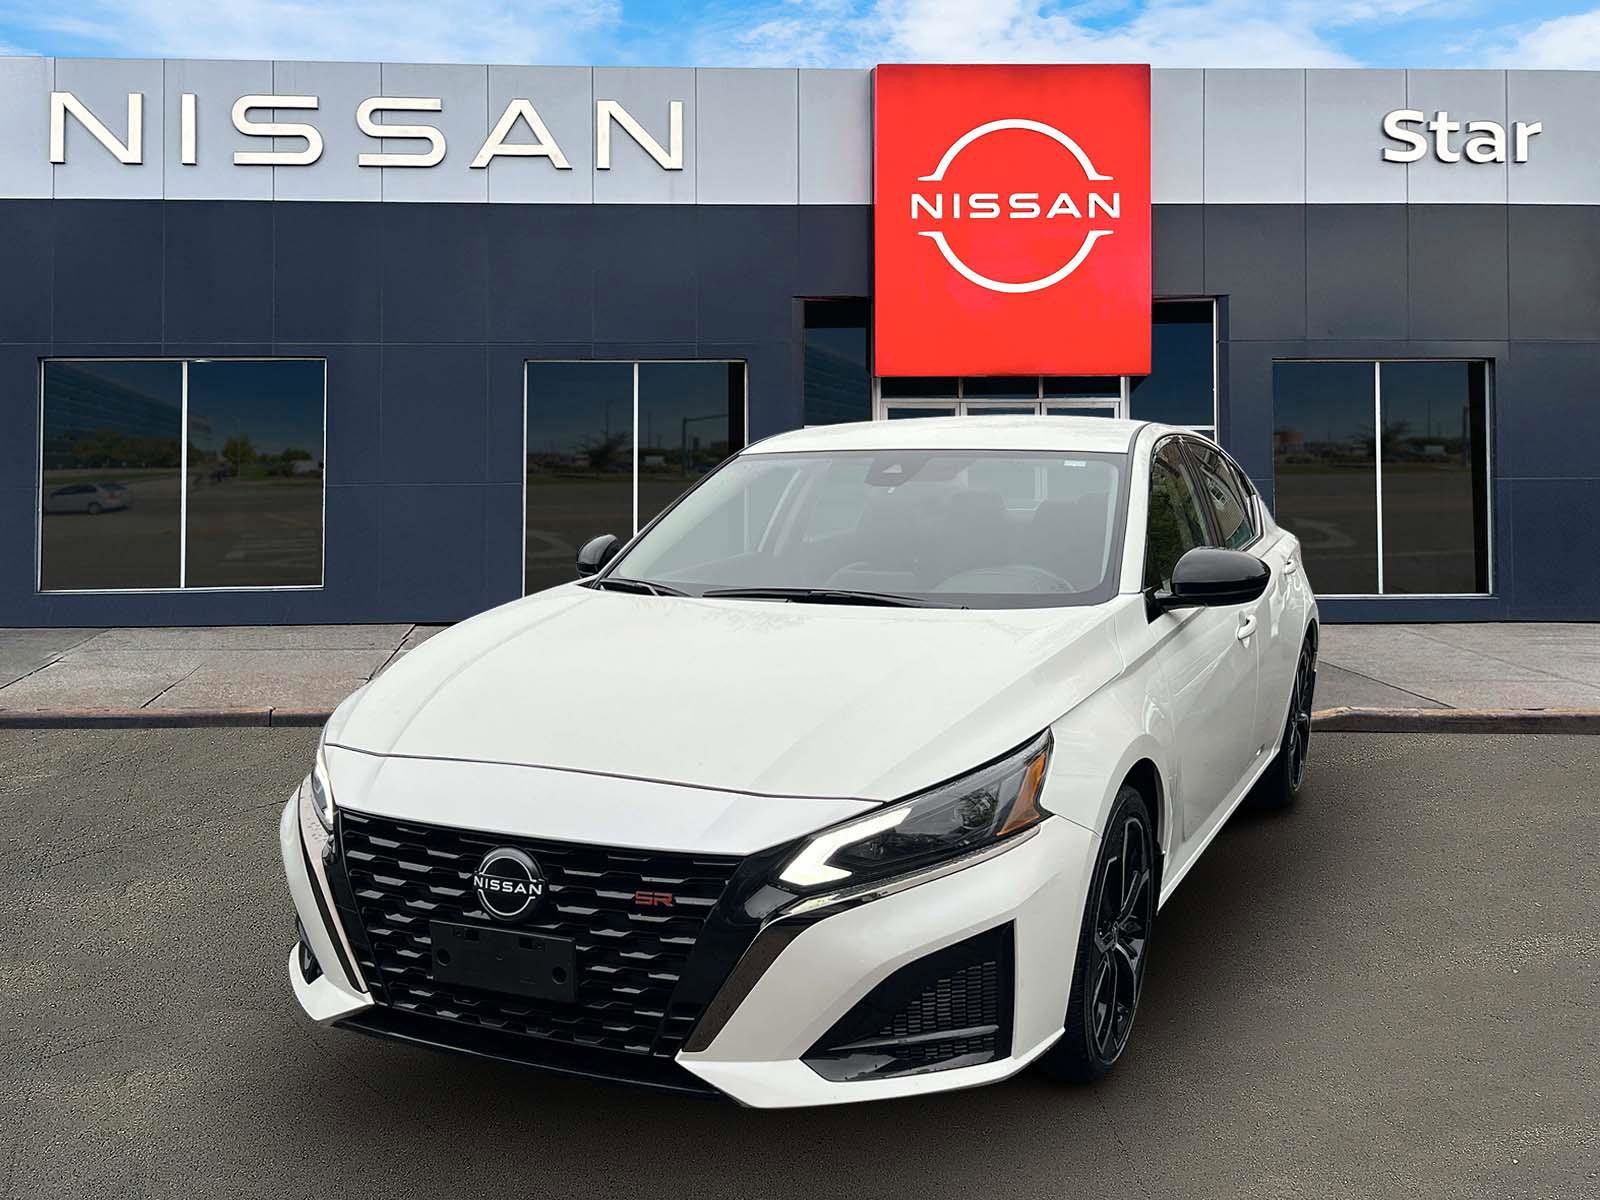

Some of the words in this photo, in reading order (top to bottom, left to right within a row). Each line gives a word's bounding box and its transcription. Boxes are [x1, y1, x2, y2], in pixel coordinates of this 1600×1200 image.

[49, 91, 684, 170] NISSAN
[1382, 109, 1543, 163] Star
[910, 192, 1121, 219] NISSAN
[473, 874, 543, 896] NISSAN
[634, 890, 674, 907] SR
